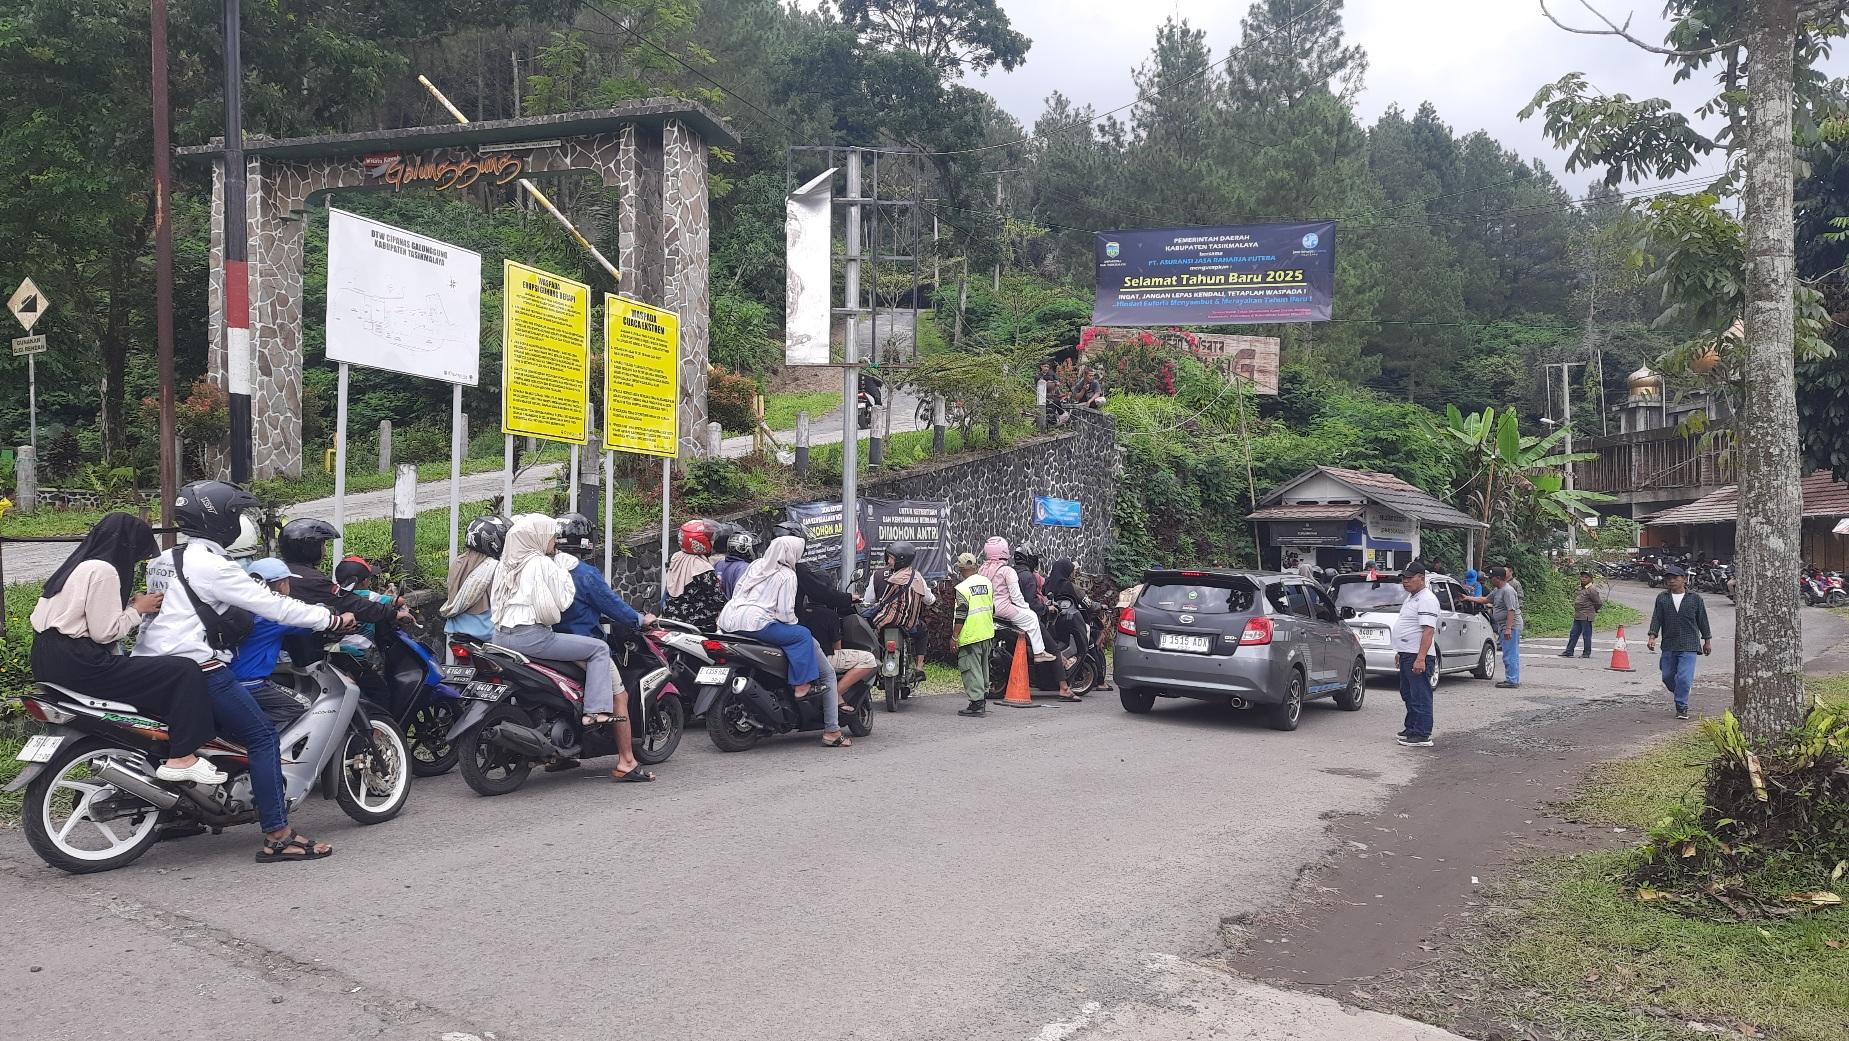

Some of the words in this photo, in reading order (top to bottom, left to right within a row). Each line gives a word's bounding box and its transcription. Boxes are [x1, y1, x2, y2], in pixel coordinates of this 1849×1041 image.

[372, 230, 385, 240] DTW
[386, 234, 410, 248] CIPANAS
[411, 242, 448, 259] GALUNGGUNG
[1174, 235, 1219, 244] PEMERINTAH
[374, 240, 406, 256] KABUPATEN
[408, 249, 445, 266] TASIKMALAYA
[1124, 276, 1177, 287] Selamat
[1181, 274, 1224, 284] Tahun
[1229, 272, 1262, 283] Baru
[1266, 270, 1304, 281] 2025
[631, 309, 657, 323] WASPADA
[623, 317, 642, 329] CUACA
[642, 322, 665, 335] EKSTREM
[17, 337, 40, 346] GUNAKAN
[879, 526, 915, 540] DIMOHON
[917, 526, 938, 540] ANTRI
[1170, 636, 1189, 645] 1515
